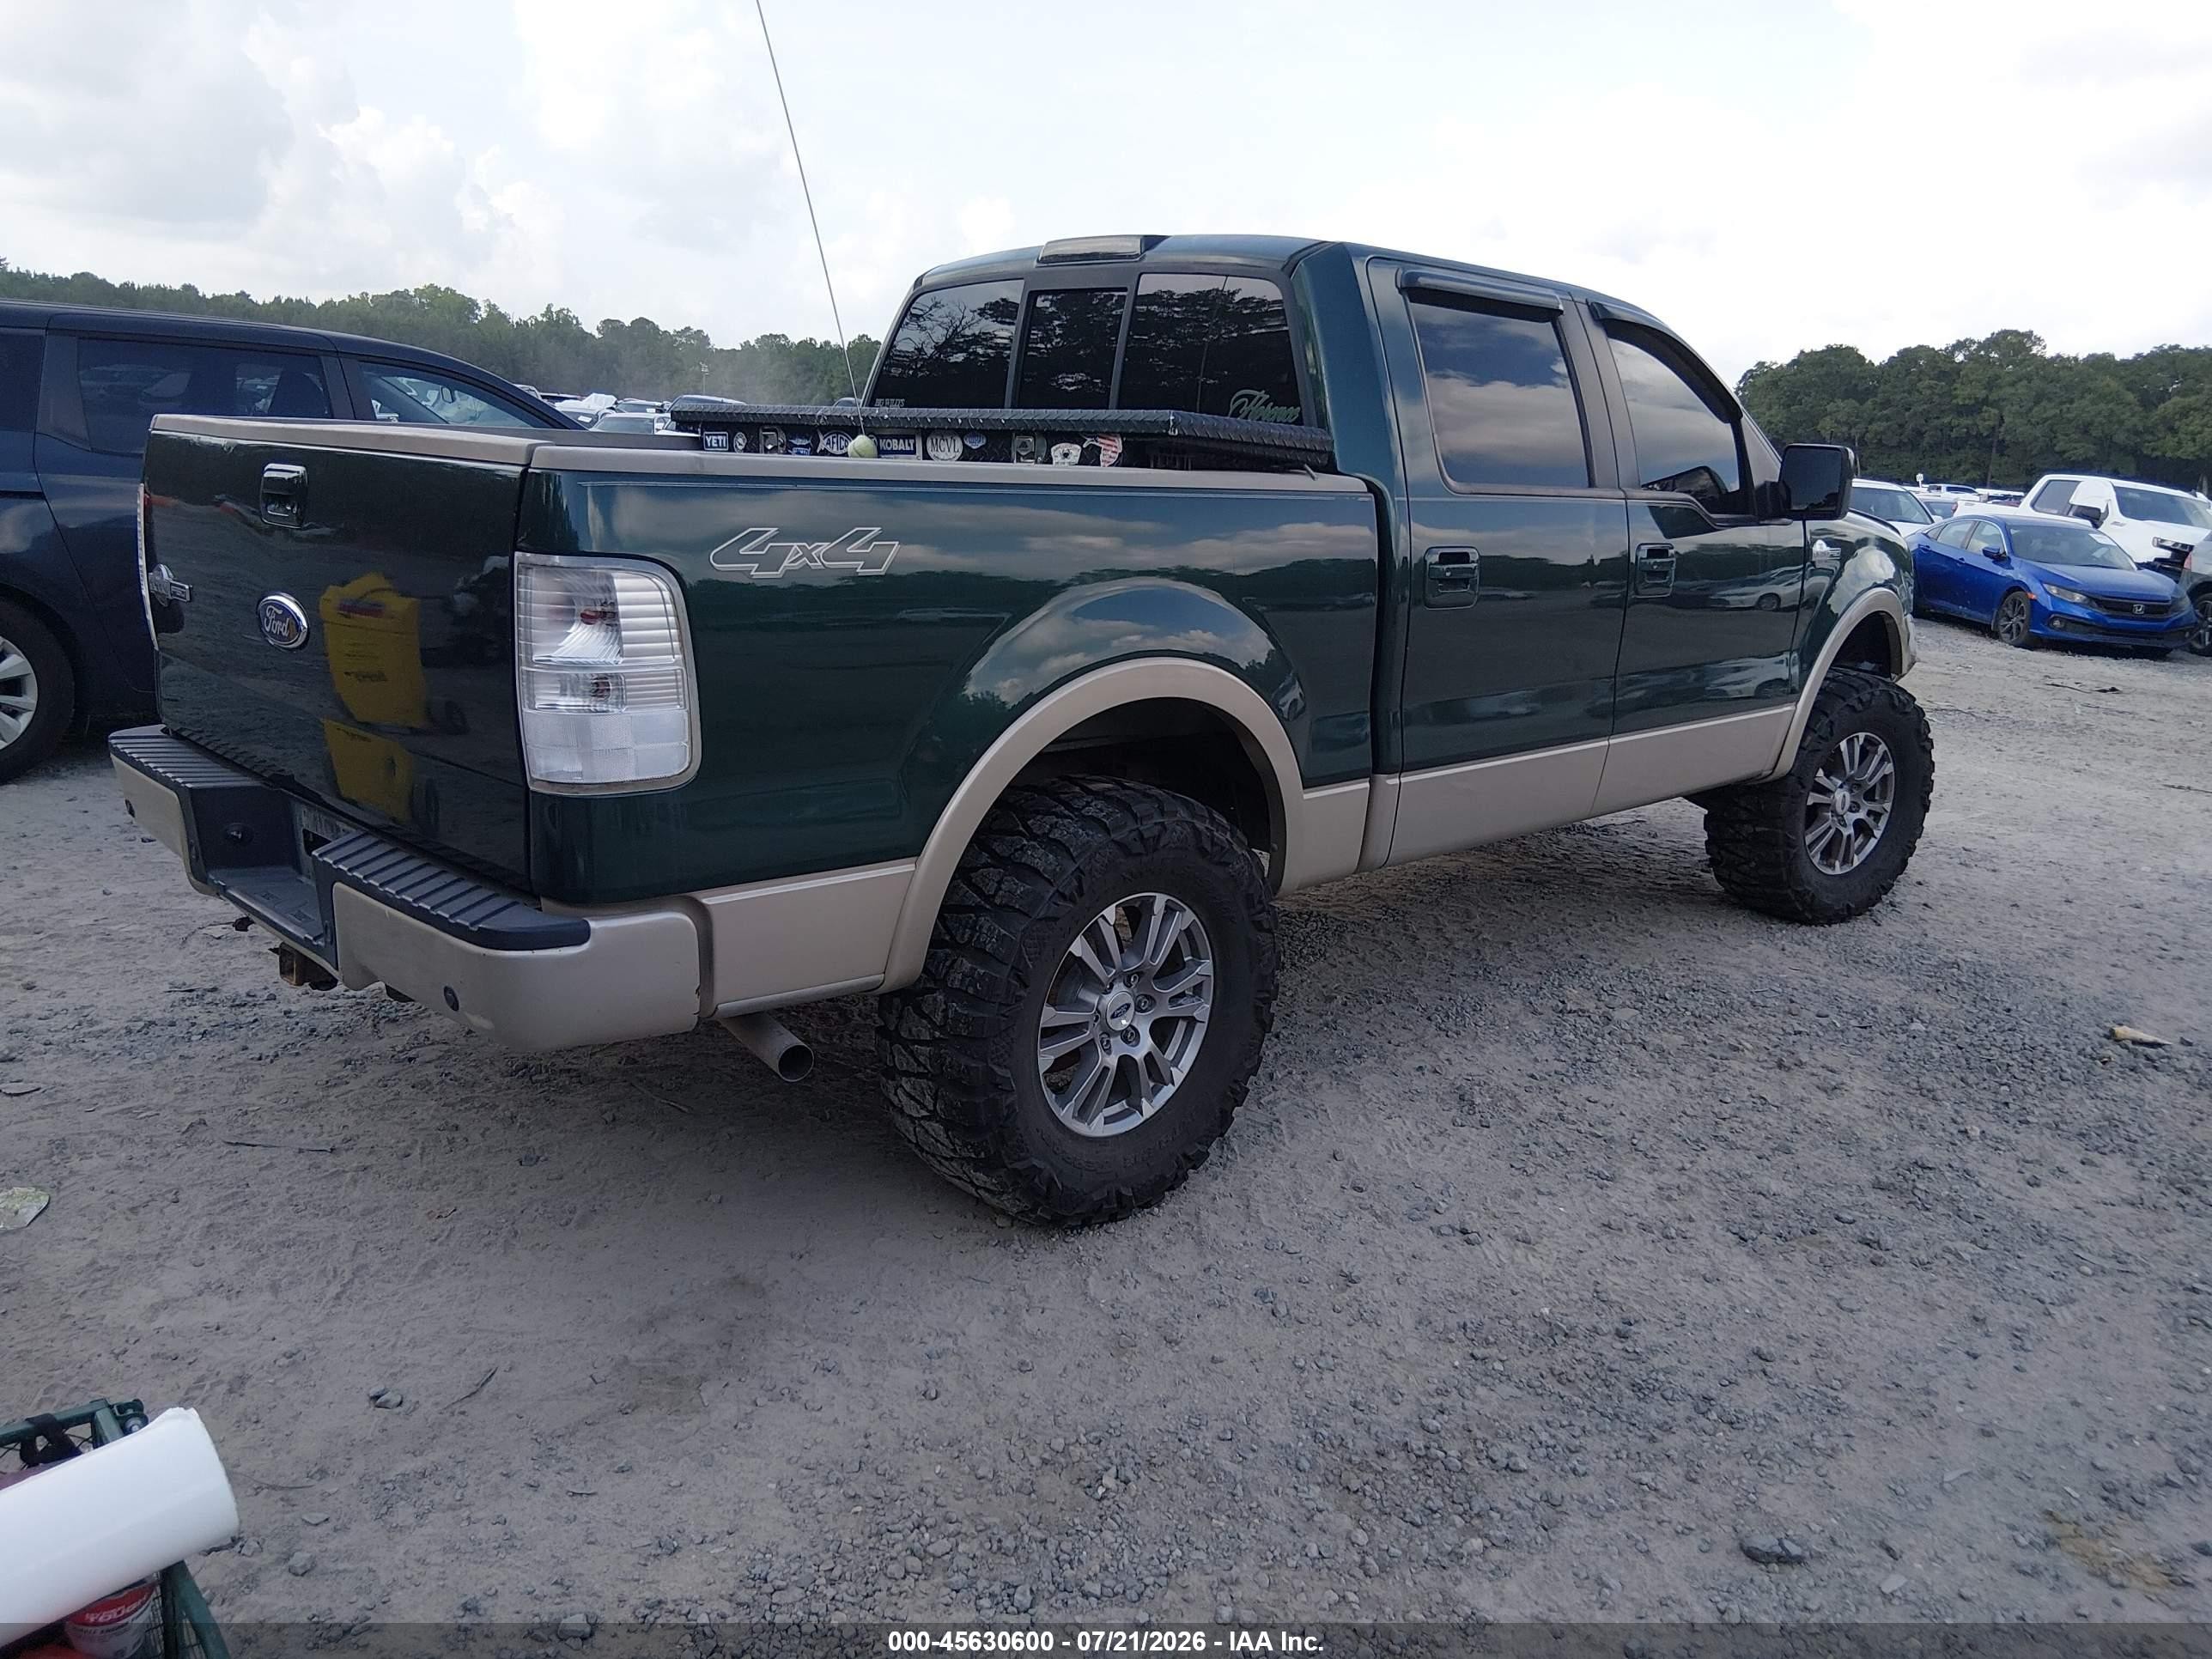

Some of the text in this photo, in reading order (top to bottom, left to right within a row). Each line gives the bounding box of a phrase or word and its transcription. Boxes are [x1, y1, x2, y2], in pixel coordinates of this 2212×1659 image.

[705, 435, 726, 447] YETI
[879, 438, 915, 451] KOBALT
[710, 527, 900, 579] 4x4
[264, 605, 290, 637] Ford
